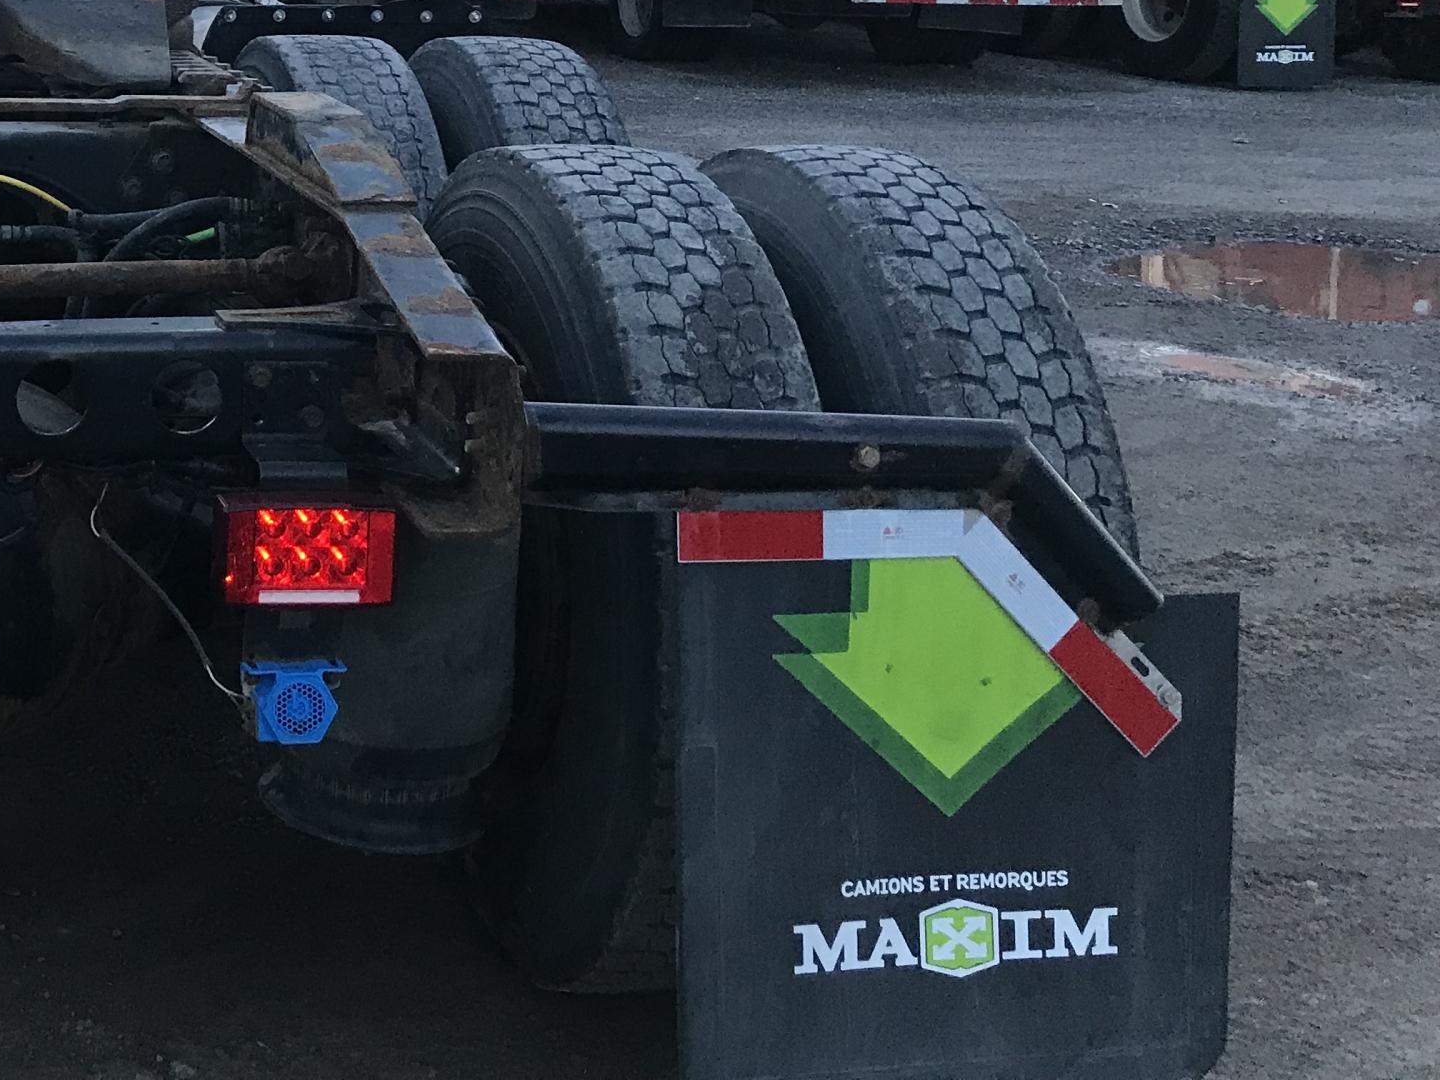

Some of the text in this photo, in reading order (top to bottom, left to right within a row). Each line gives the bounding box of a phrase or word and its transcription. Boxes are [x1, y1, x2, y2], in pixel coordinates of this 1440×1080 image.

[840, 870, 1069, 898] CAMIONS ET REMORQUES
[793, 898, 1118, 977] MAXIM
